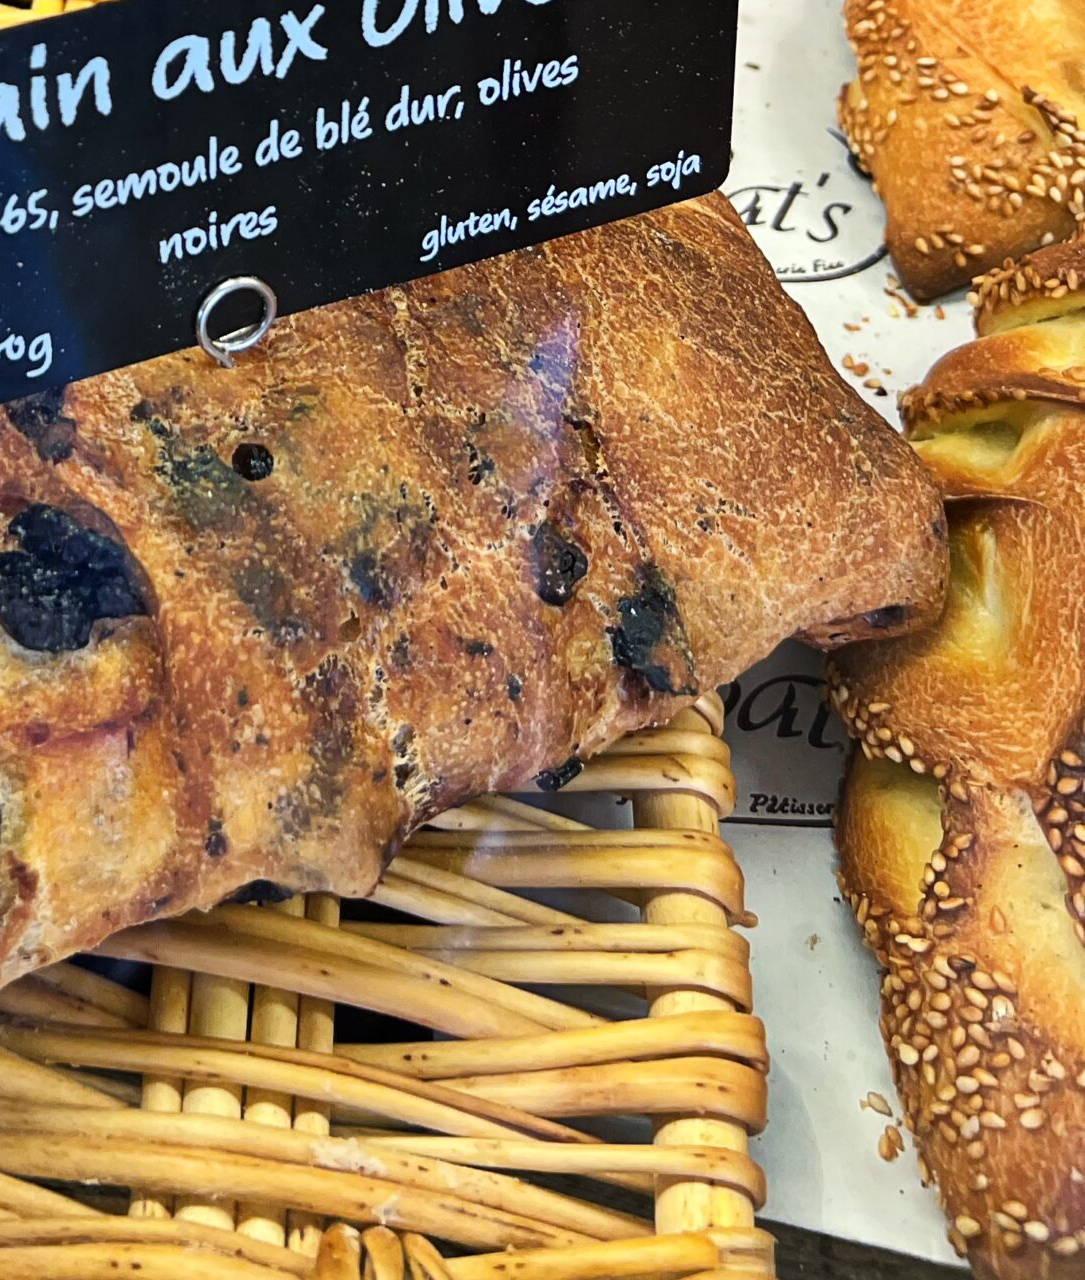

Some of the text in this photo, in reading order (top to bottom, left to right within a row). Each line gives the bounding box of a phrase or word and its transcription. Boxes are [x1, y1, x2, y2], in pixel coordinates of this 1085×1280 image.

[152, 4, 328, 100] aux
[71, 136, 243, 217] semoule
[255, 119, 303, 166] de
[315, 96, 373, 149] blé
[385, 84, 465, 129] dur,
[477, 54, 579, 106] olives
[159, 205, 278, 264] noires
[419, 154, 700, 263] gluten, sésame, soja
